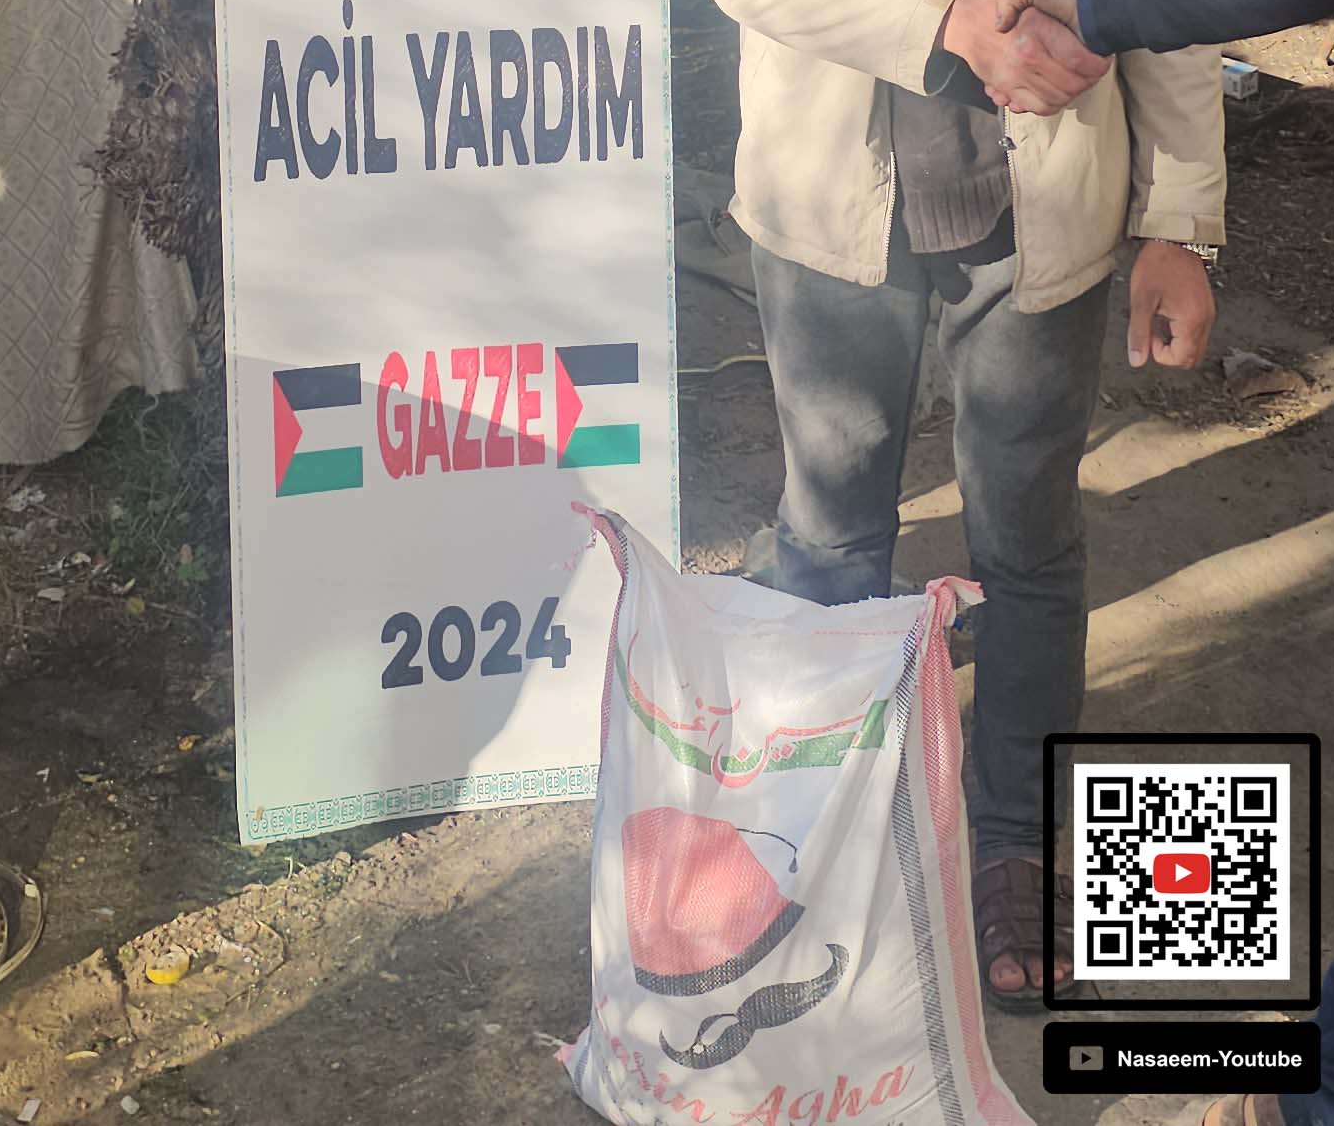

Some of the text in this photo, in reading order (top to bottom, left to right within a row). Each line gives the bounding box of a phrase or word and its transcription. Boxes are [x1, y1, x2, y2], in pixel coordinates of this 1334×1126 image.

[406, 24, 643, 170] YARDIM
[377, 342, 546, 479] GAZZE
[380, 597, 571, 689] 2024
